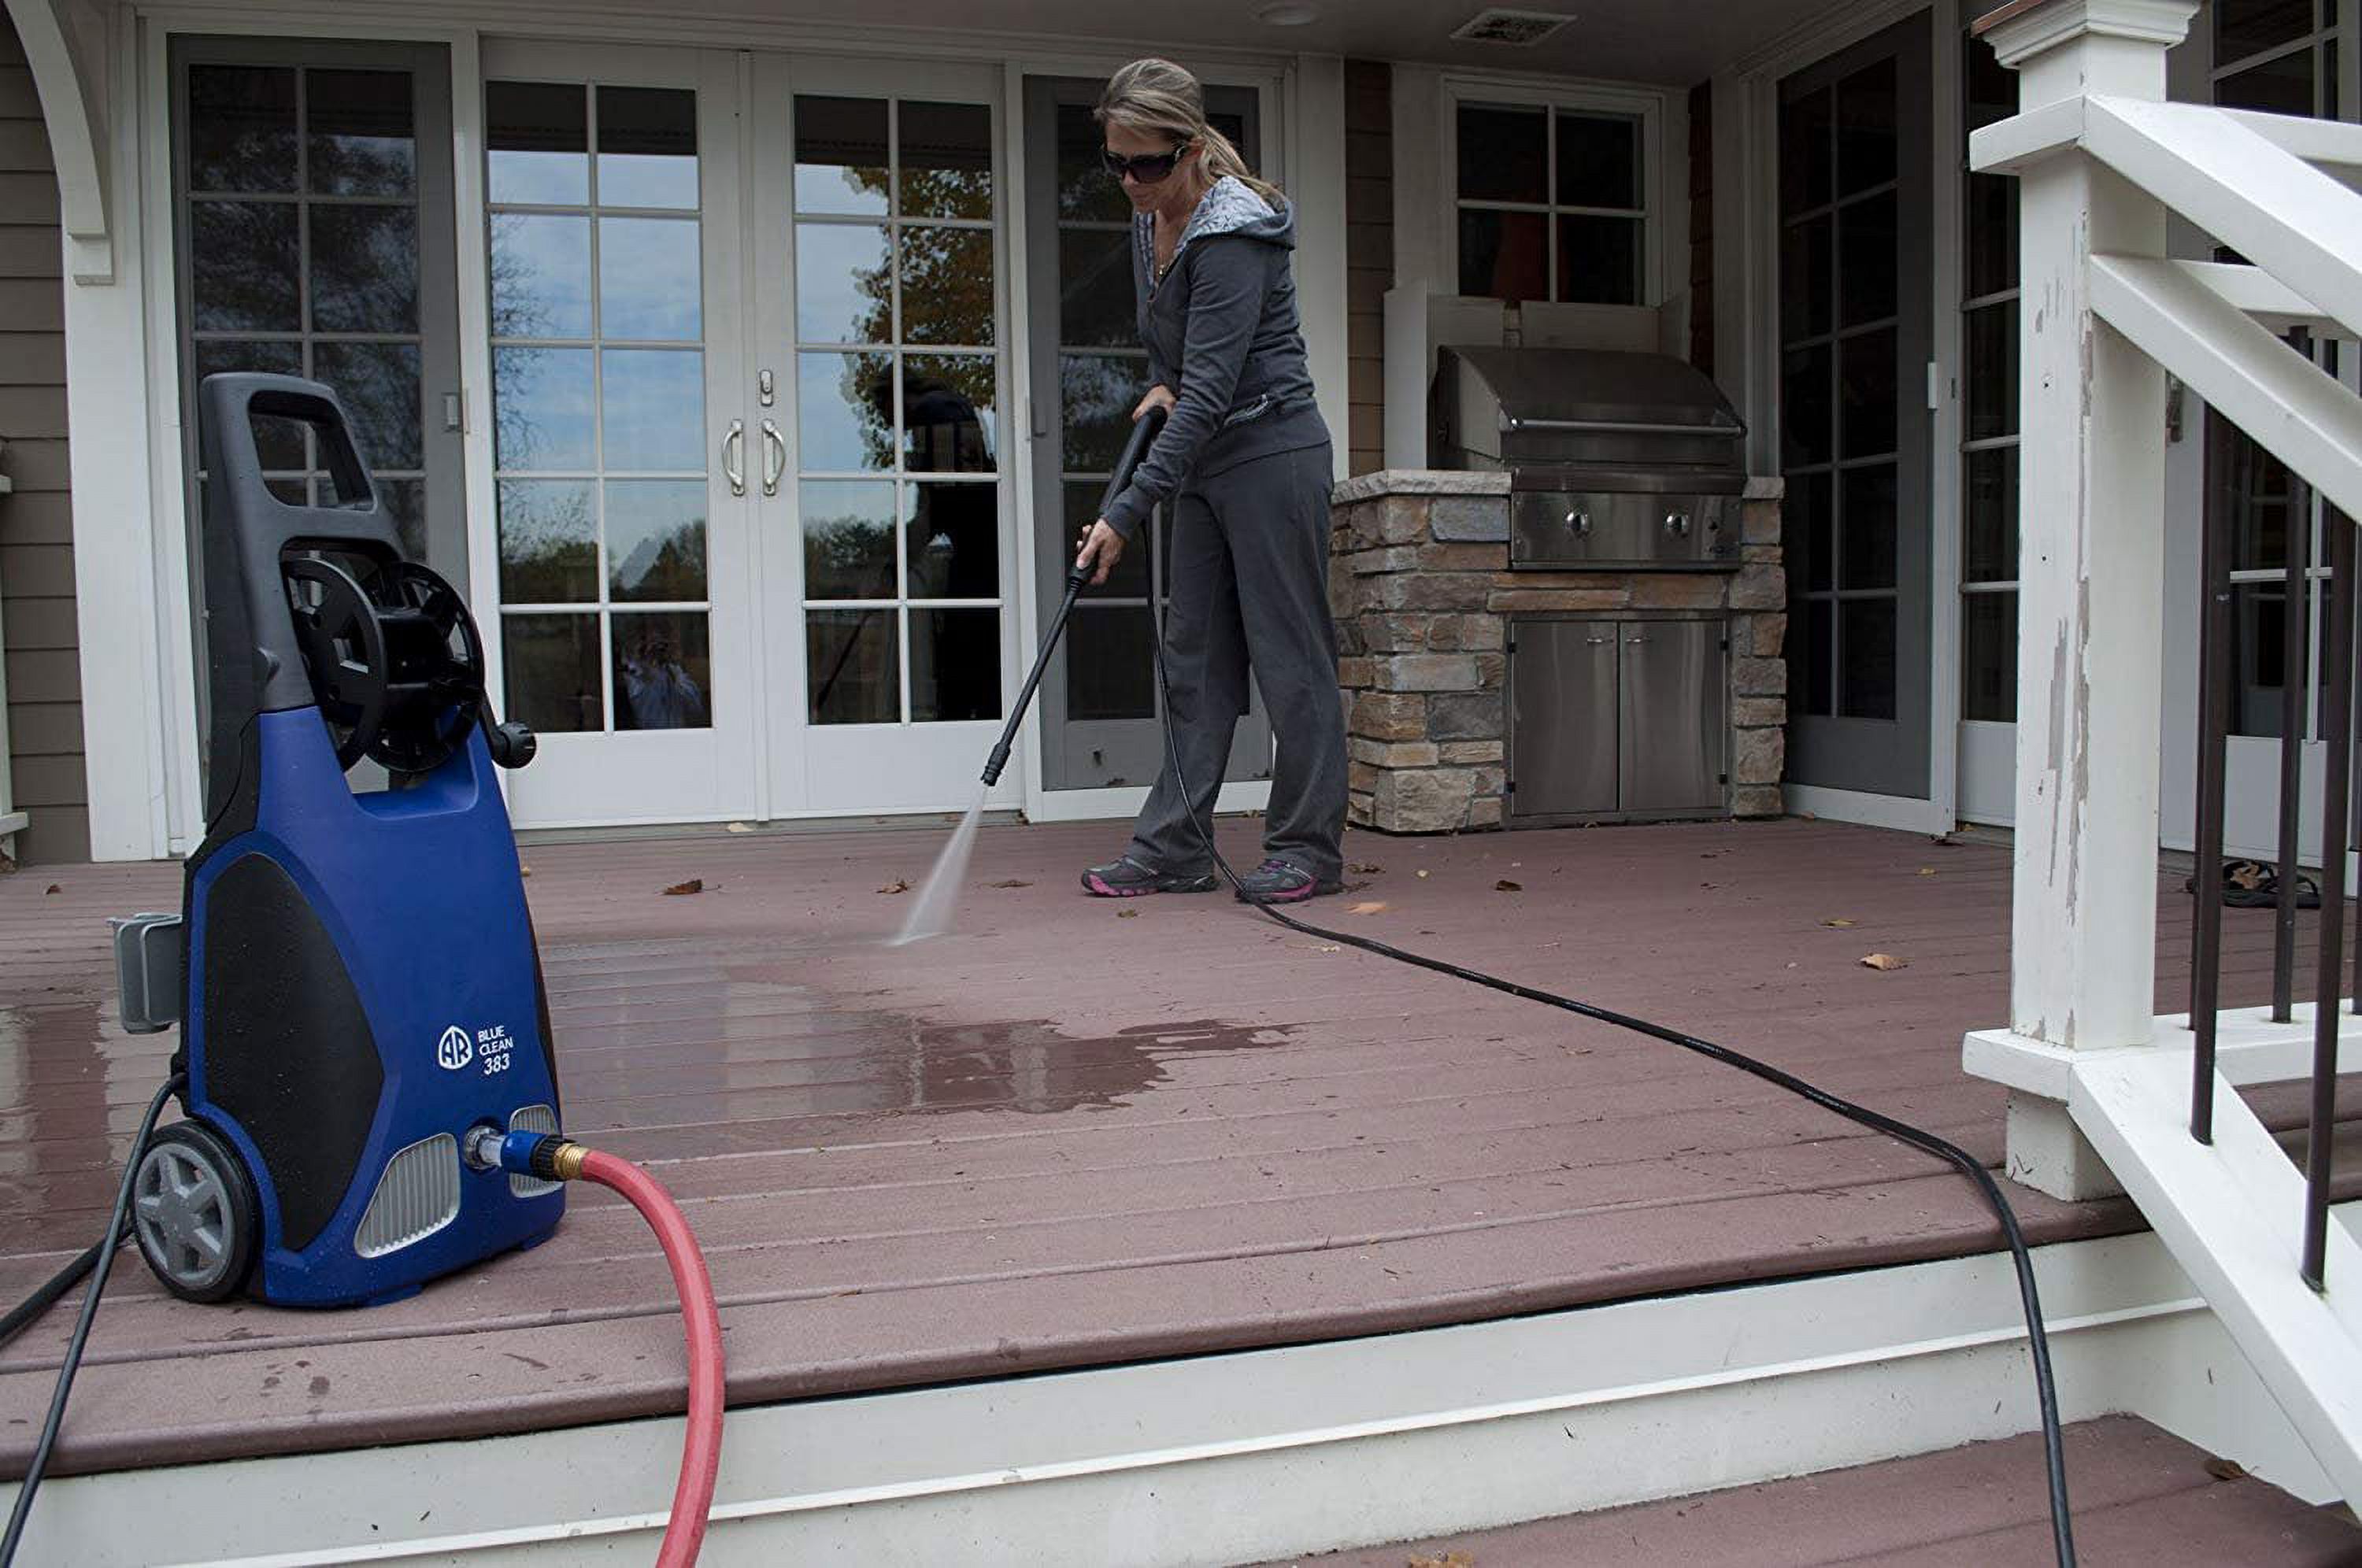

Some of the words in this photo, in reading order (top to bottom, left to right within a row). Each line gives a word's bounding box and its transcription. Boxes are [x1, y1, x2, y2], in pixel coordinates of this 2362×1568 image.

[477, 1026, 505, 1043] BLUE
[440, 1028, 471, 1067] AR
[479, 1037, 513, 1056] CLEAN
[483, 1053, 510, 1075] 383
